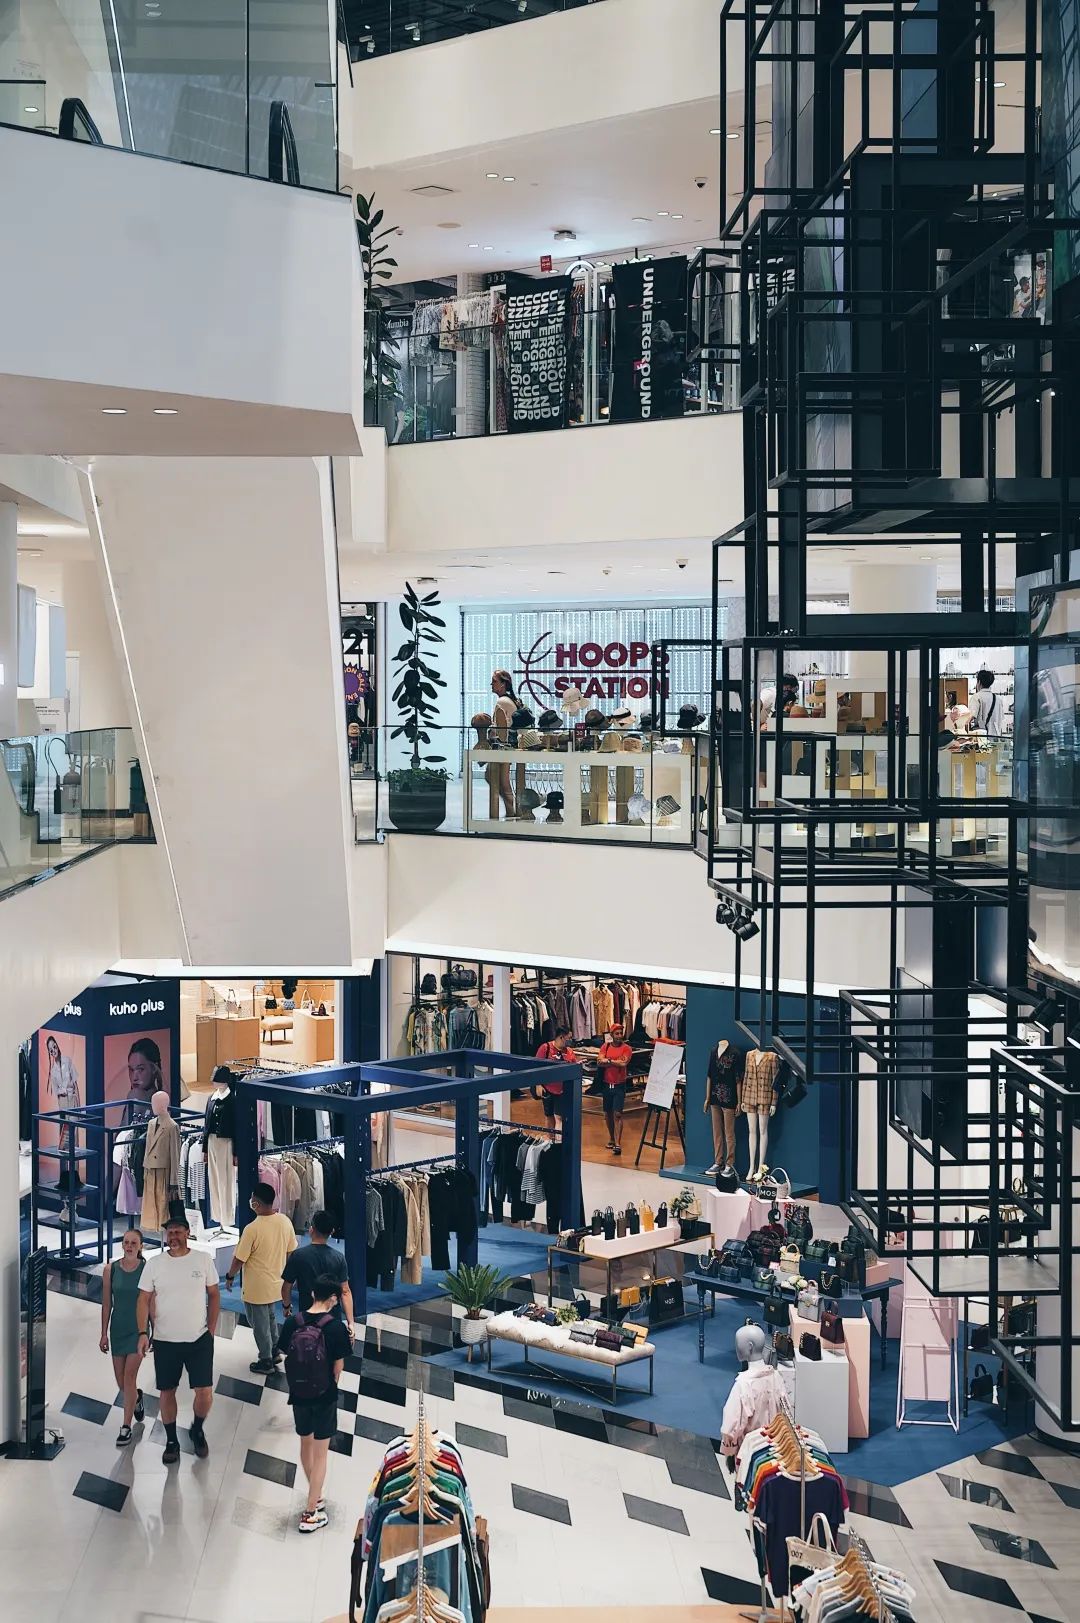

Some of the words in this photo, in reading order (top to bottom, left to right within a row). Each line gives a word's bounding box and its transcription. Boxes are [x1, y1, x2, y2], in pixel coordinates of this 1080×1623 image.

[640, 267, 654, 419] UNDERGROUND
[342, 628, 376, 655] 21
[555, 642, 670, 668] HOOPS
[554, 676, 670, 699] STATION
[64, 1002, 82, 1016] plus
[109, 1002, 138, 1016] kuho
[140, 999, 165, 1015] plus
